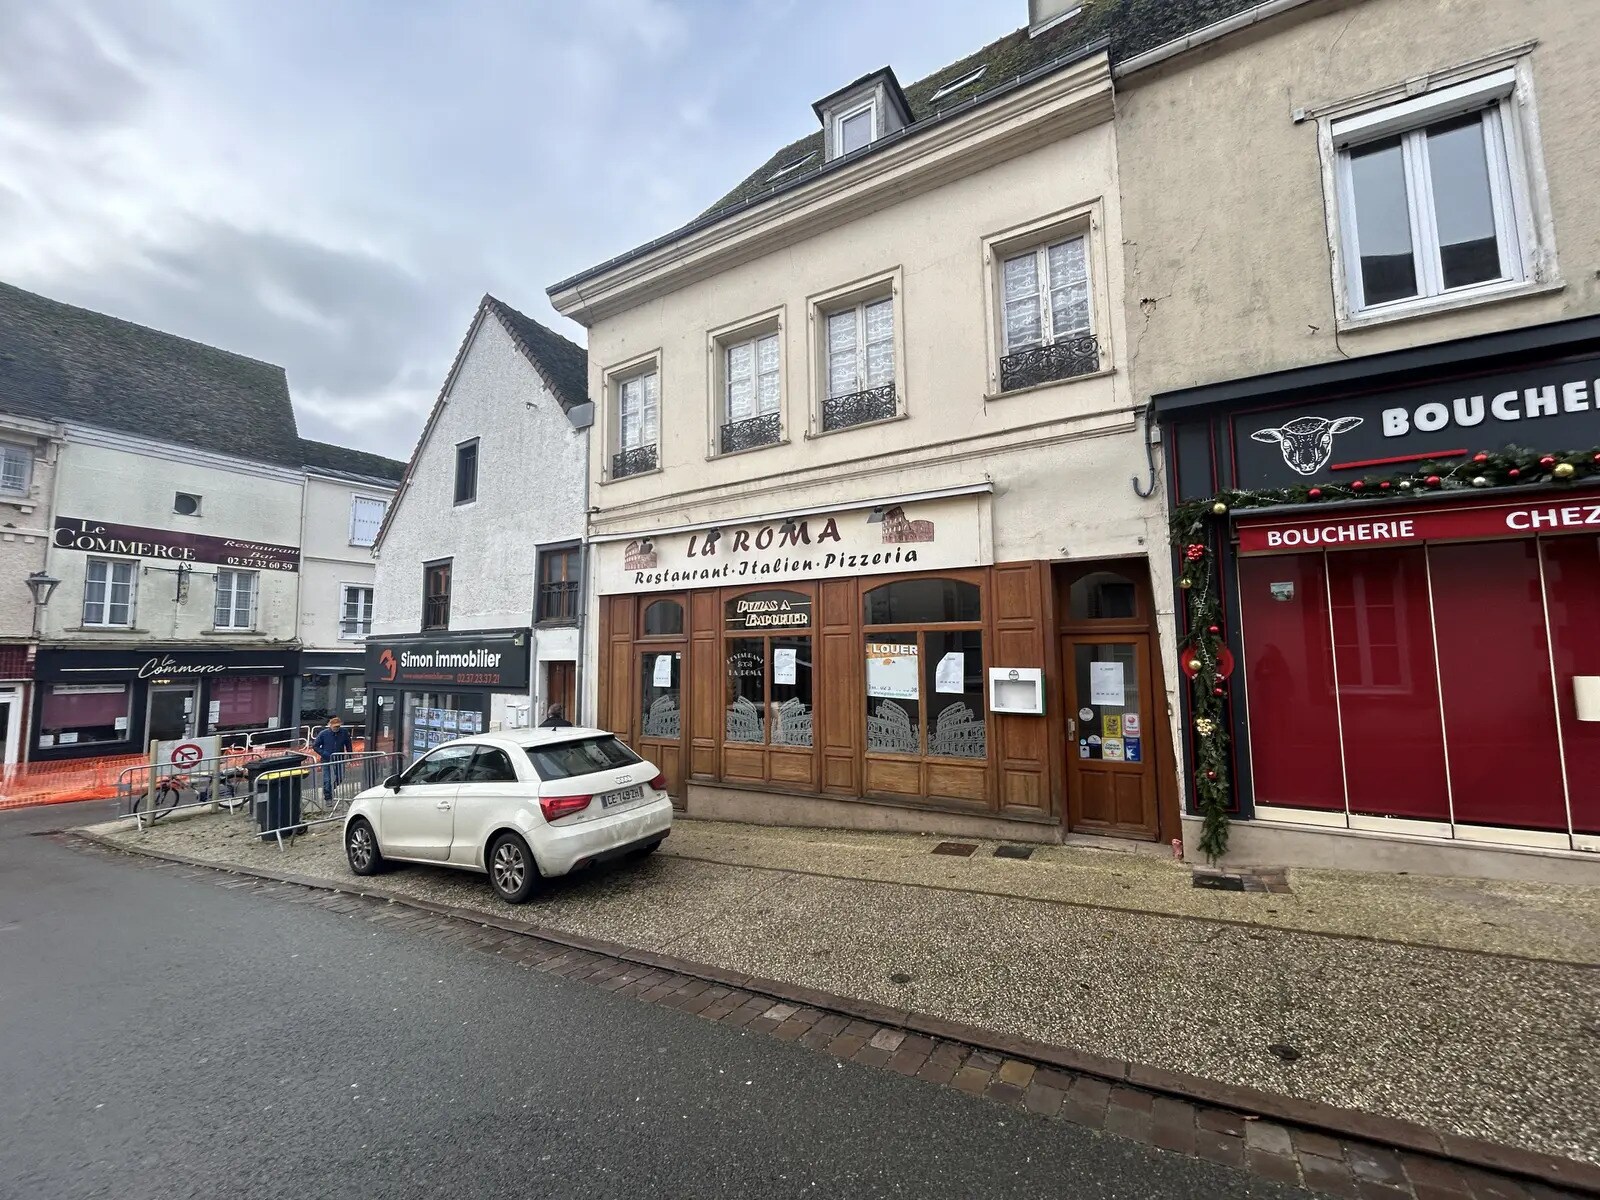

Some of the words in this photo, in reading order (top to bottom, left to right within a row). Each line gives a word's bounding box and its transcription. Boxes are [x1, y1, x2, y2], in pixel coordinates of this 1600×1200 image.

[1381, 378, 1600, 437] BOUCHE
[81, 520, 106, 535] Le
[1266, 520, 1415, 547] BOUCHERIE
[1505, 505, 1600, 530] CHEZ
[53, 527, 196, 560] COMMERCE
[687, 529, 721, 558] LA
[732, 517, 842, 553] ROMA
[224, 540, 300, 555] Restaurant
[250, 551, 276, 559] Bar
[227, 556, 239, 565] 02
[241, 558, 254, 566] 37
[255, 560, 267, 568] 32
[269, 561, 280, 569] 60
[281, 563, 293, 571] 59
[634, 562, 729, 585] Restaurant
[738, 556, 820, 576] Italien
[824, 547, 918, 569] Pizzeria
[737, 600, 778, 613] PIZZAS
[745, 613, 808, 626] EMPORTER
[400, 650, 433, 668] Simon
[435, 648, 502, 668] immobilier
[873, 644, 918, 655] LOUER
[138, 657, 226, 679] Commerce
